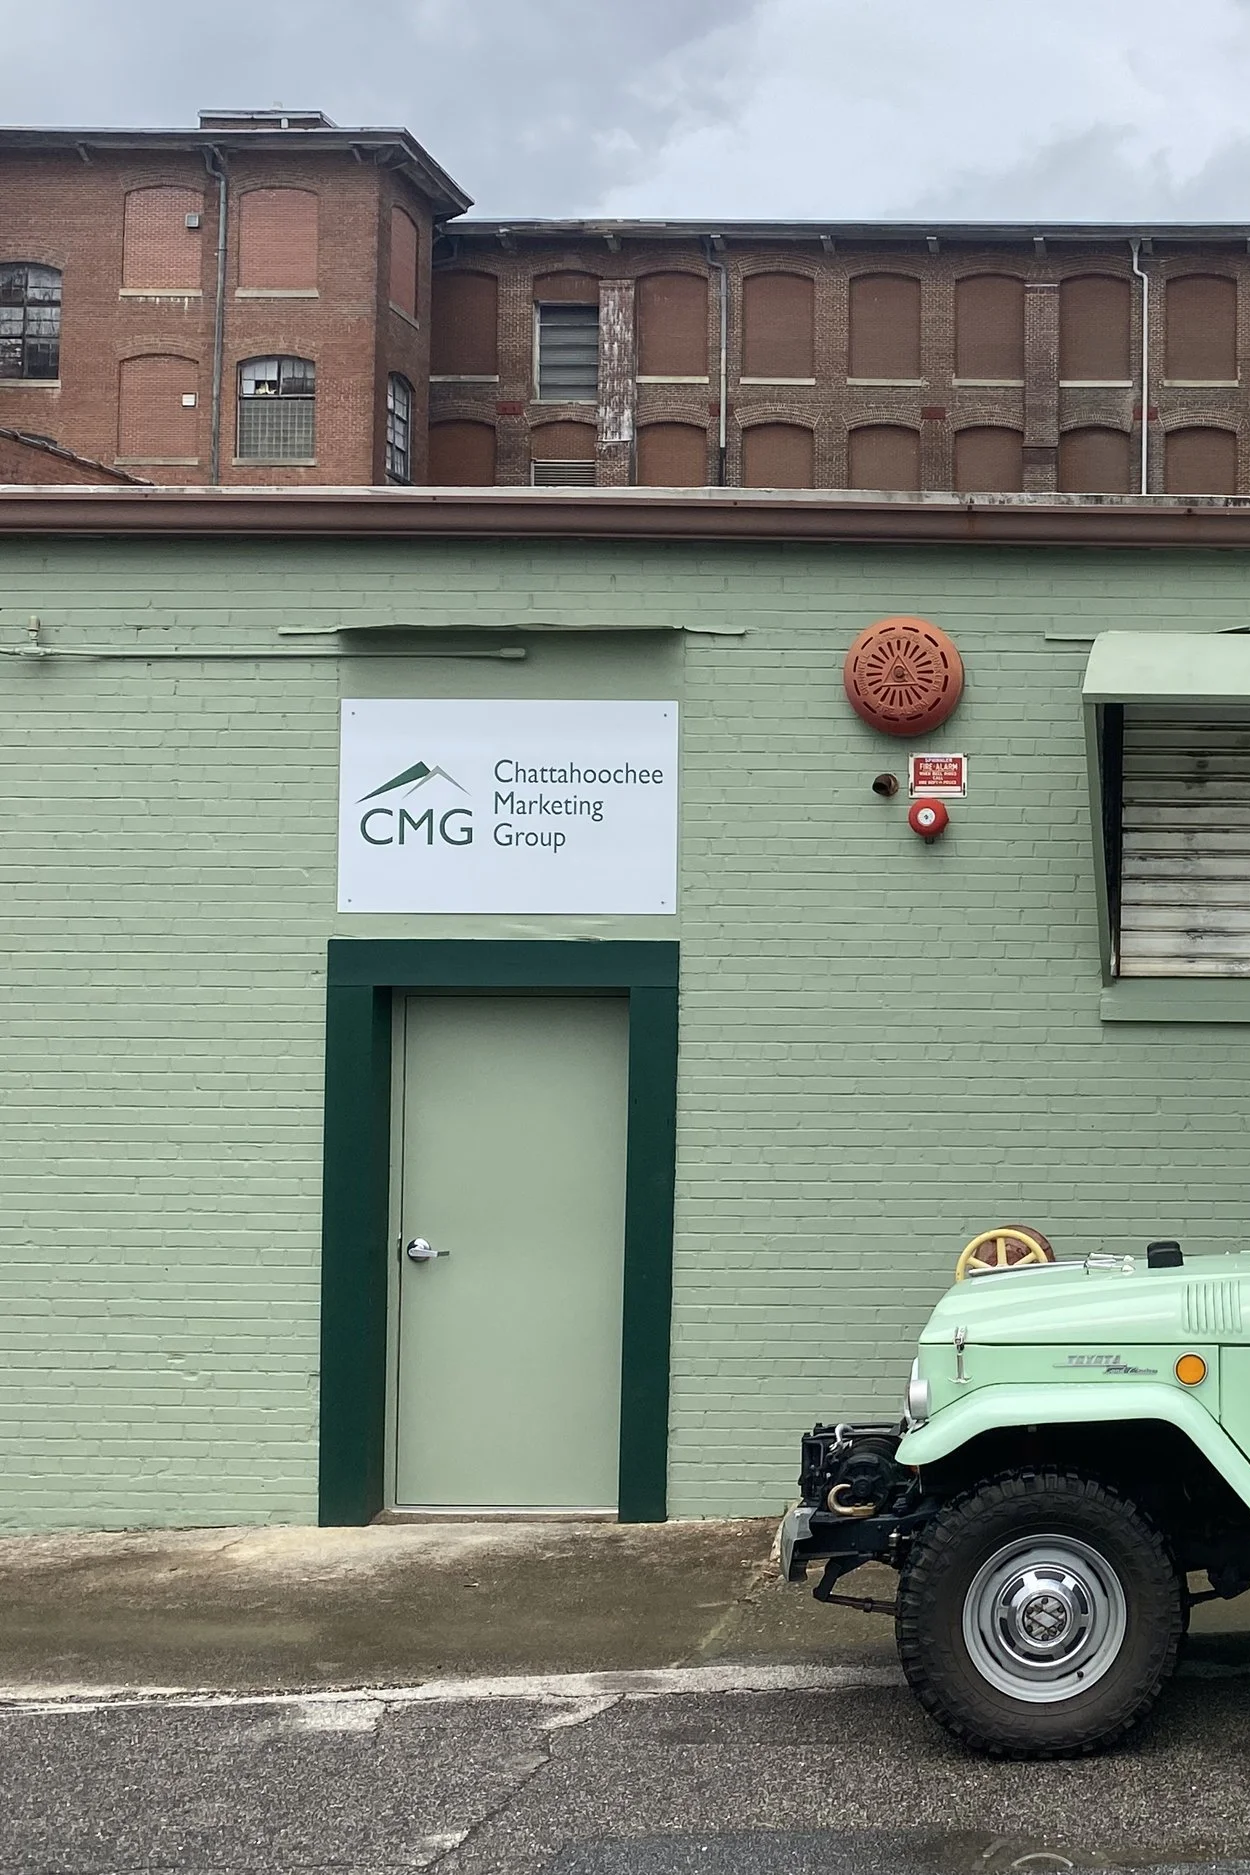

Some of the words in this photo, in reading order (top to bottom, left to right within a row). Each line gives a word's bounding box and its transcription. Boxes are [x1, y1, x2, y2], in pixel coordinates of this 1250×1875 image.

[494, 759, 664, 785] Chattahoochee
[494, 790, 604, 822] Marketing
[360, 808, 473, 846] CMG
[493, 822, 566, 853] Group
[1067, 1355, 1121, 1365] TOYOTA
